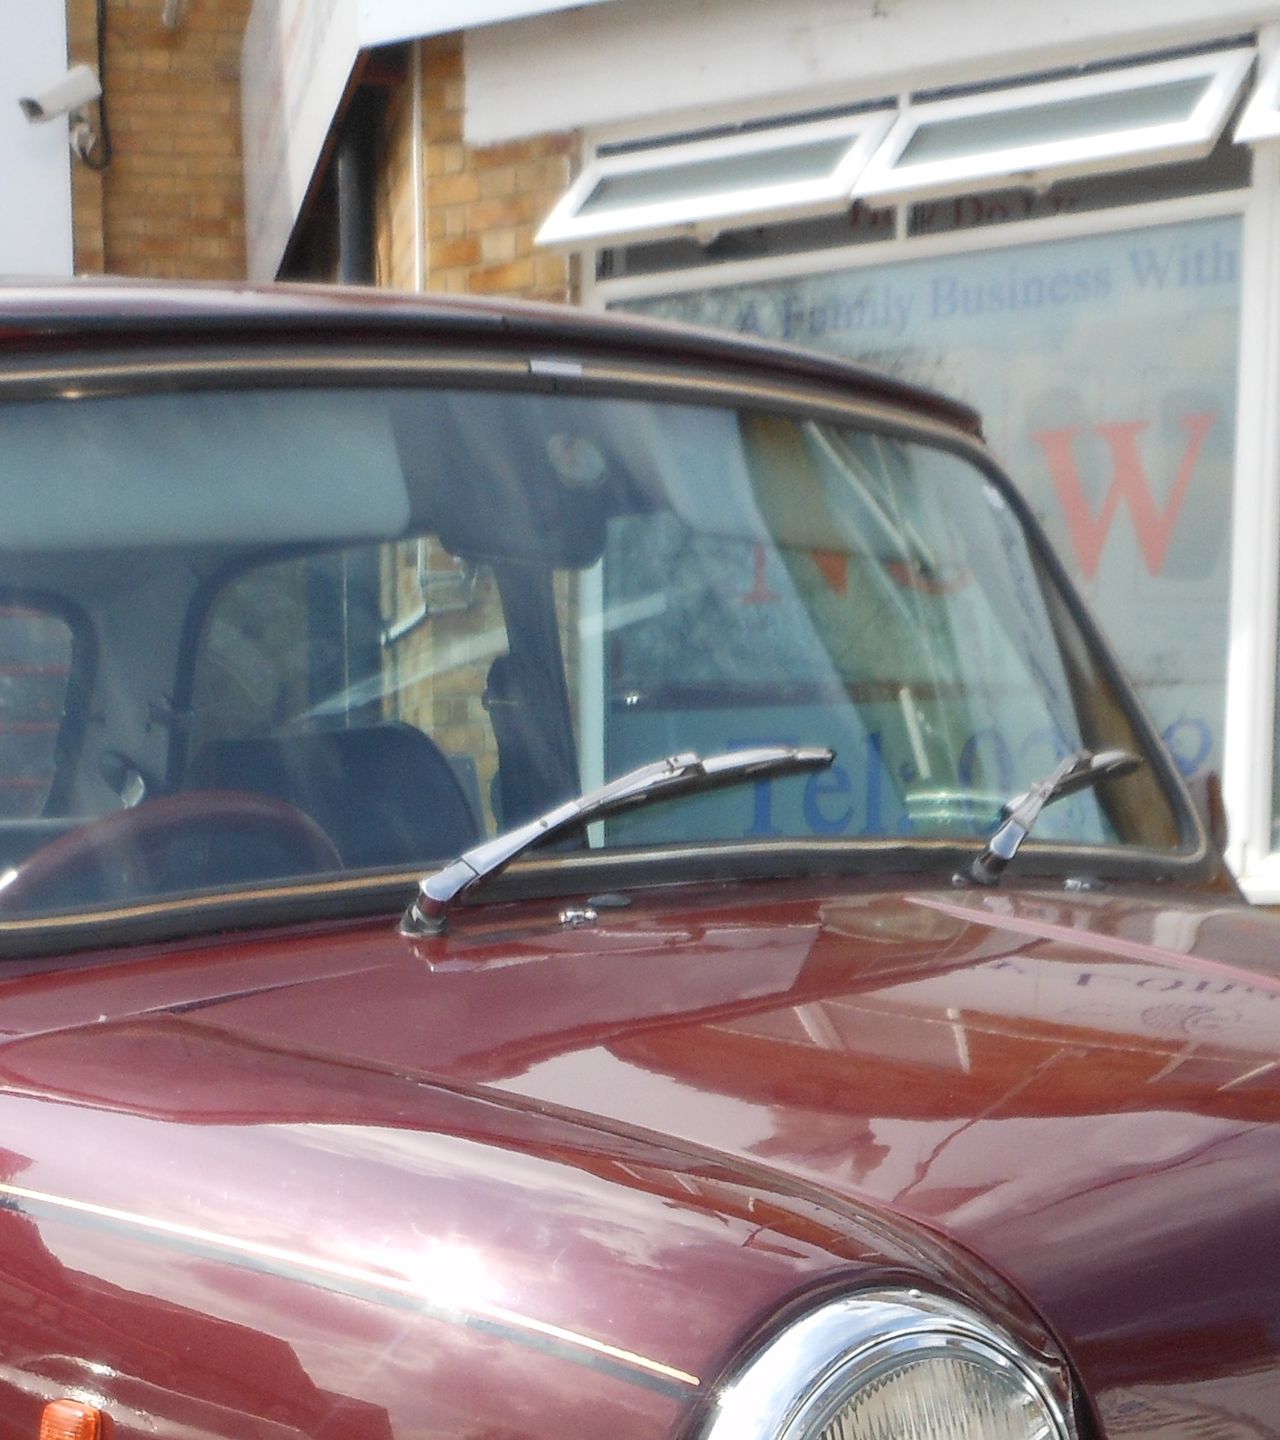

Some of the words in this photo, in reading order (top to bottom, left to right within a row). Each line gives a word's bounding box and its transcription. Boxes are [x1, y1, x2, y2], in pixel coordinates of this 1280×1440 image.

[780, 276, 916, 340] Family
[926, 262, 1113, 321] Business
[1127, 236, 1240, 290] With
